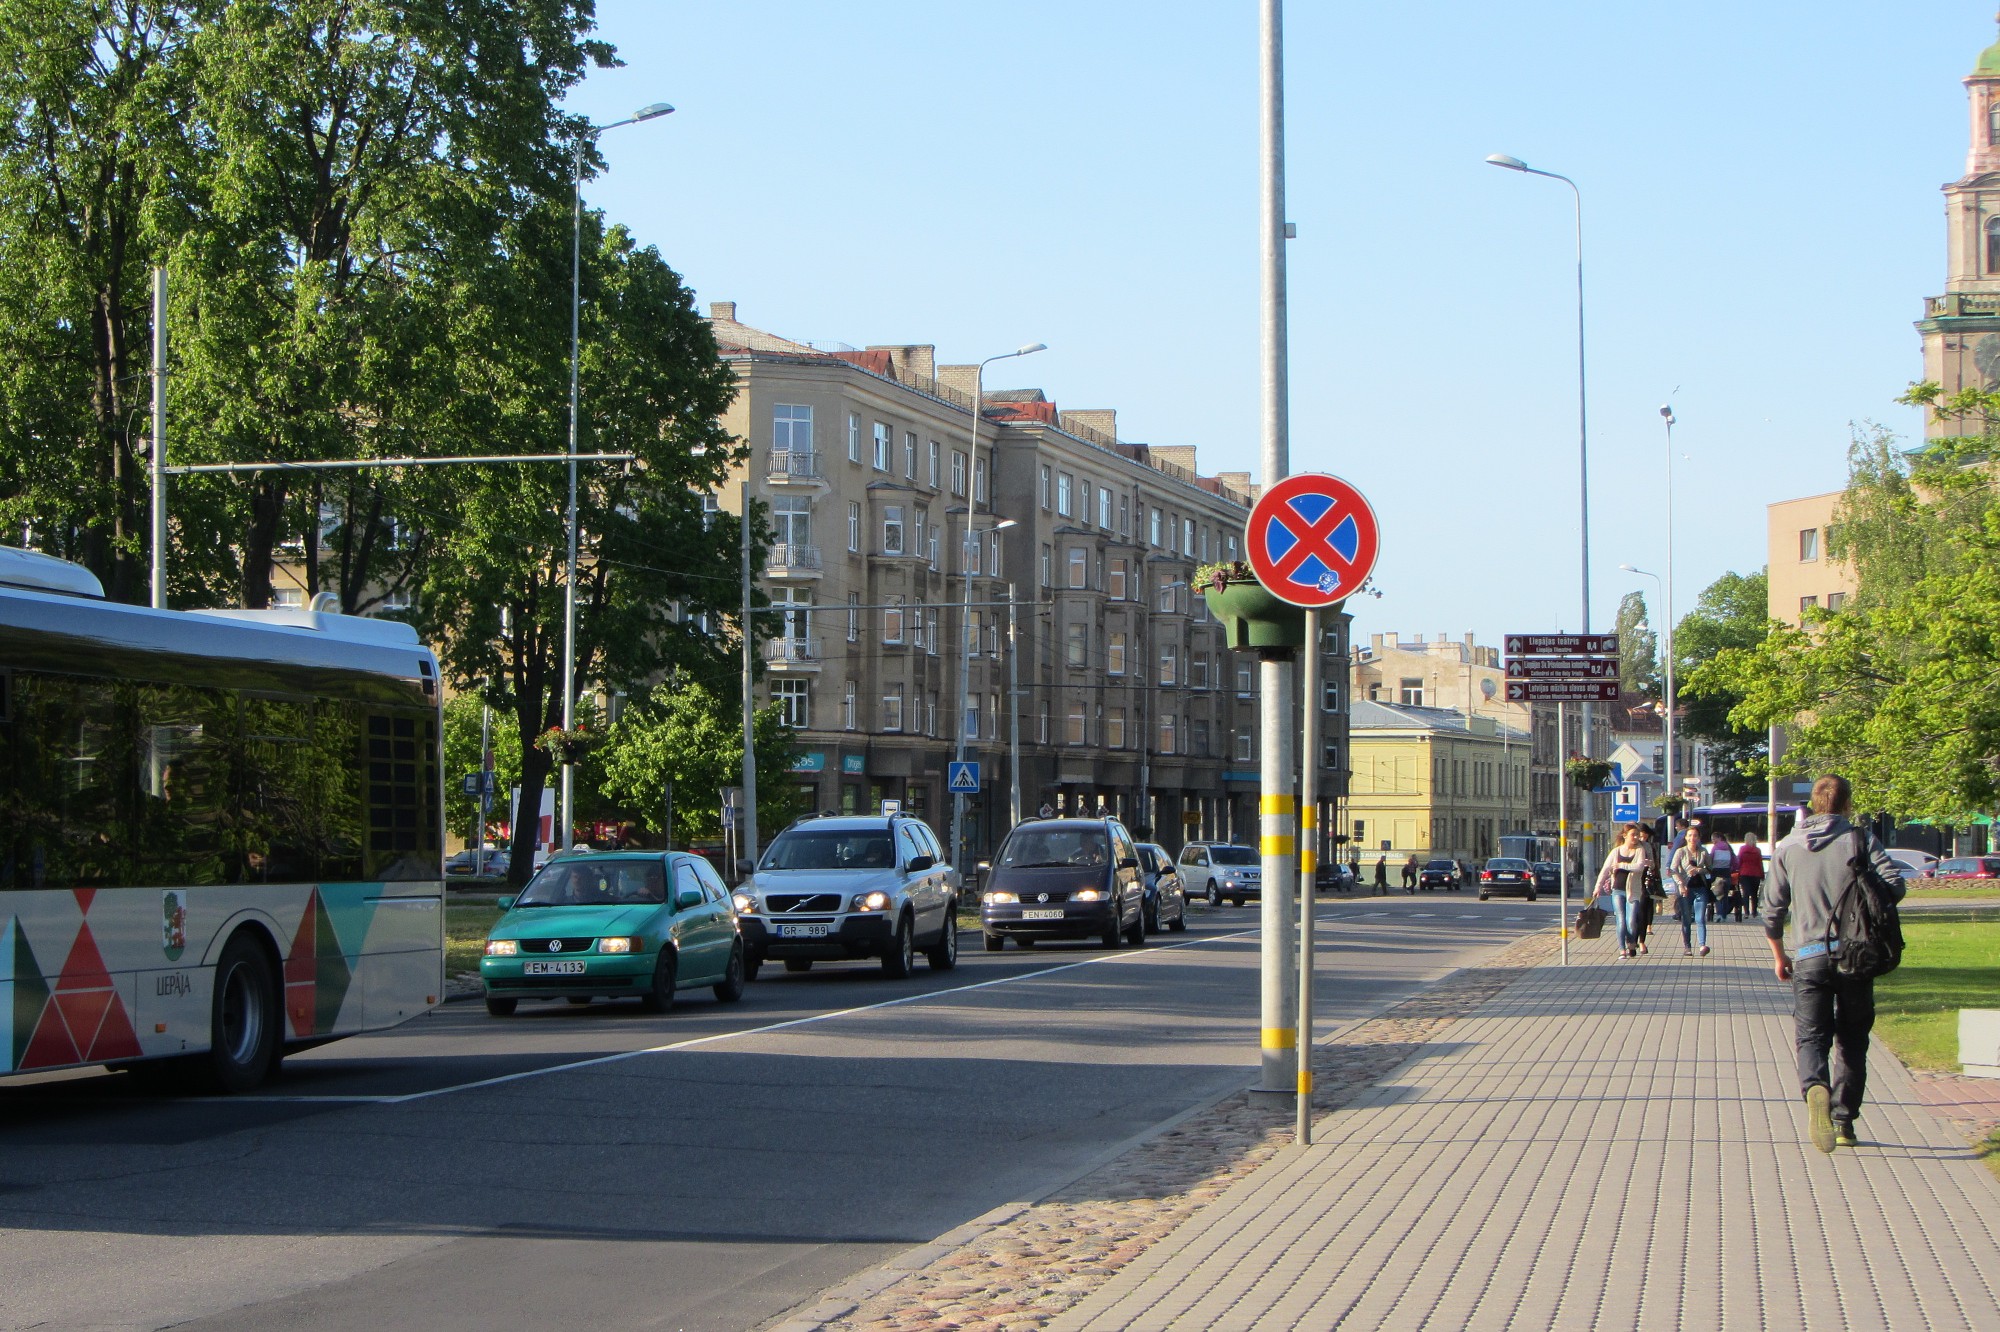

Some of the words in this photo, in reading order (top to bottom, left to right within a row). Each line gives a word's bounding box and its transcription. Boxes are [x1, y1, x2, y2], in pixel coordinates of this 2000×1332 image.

[1529, 637, 1556, 646] Liepājas
[1557, 637, 1580, 645] teātris
[1586, 641, 1597, 651] 0,4
[1591, 665, 1601, 675] 0,2
[1528, 684, 1549, 693] Latvijas
[1569, 684, 1586, 692] slavas
[1587, 684, 1600, 693] aleja
[1606, 687, 1616, 696] 0,2
[808, 926, 826, 935] 989
[532, 962, 584, 974] EM-4133
